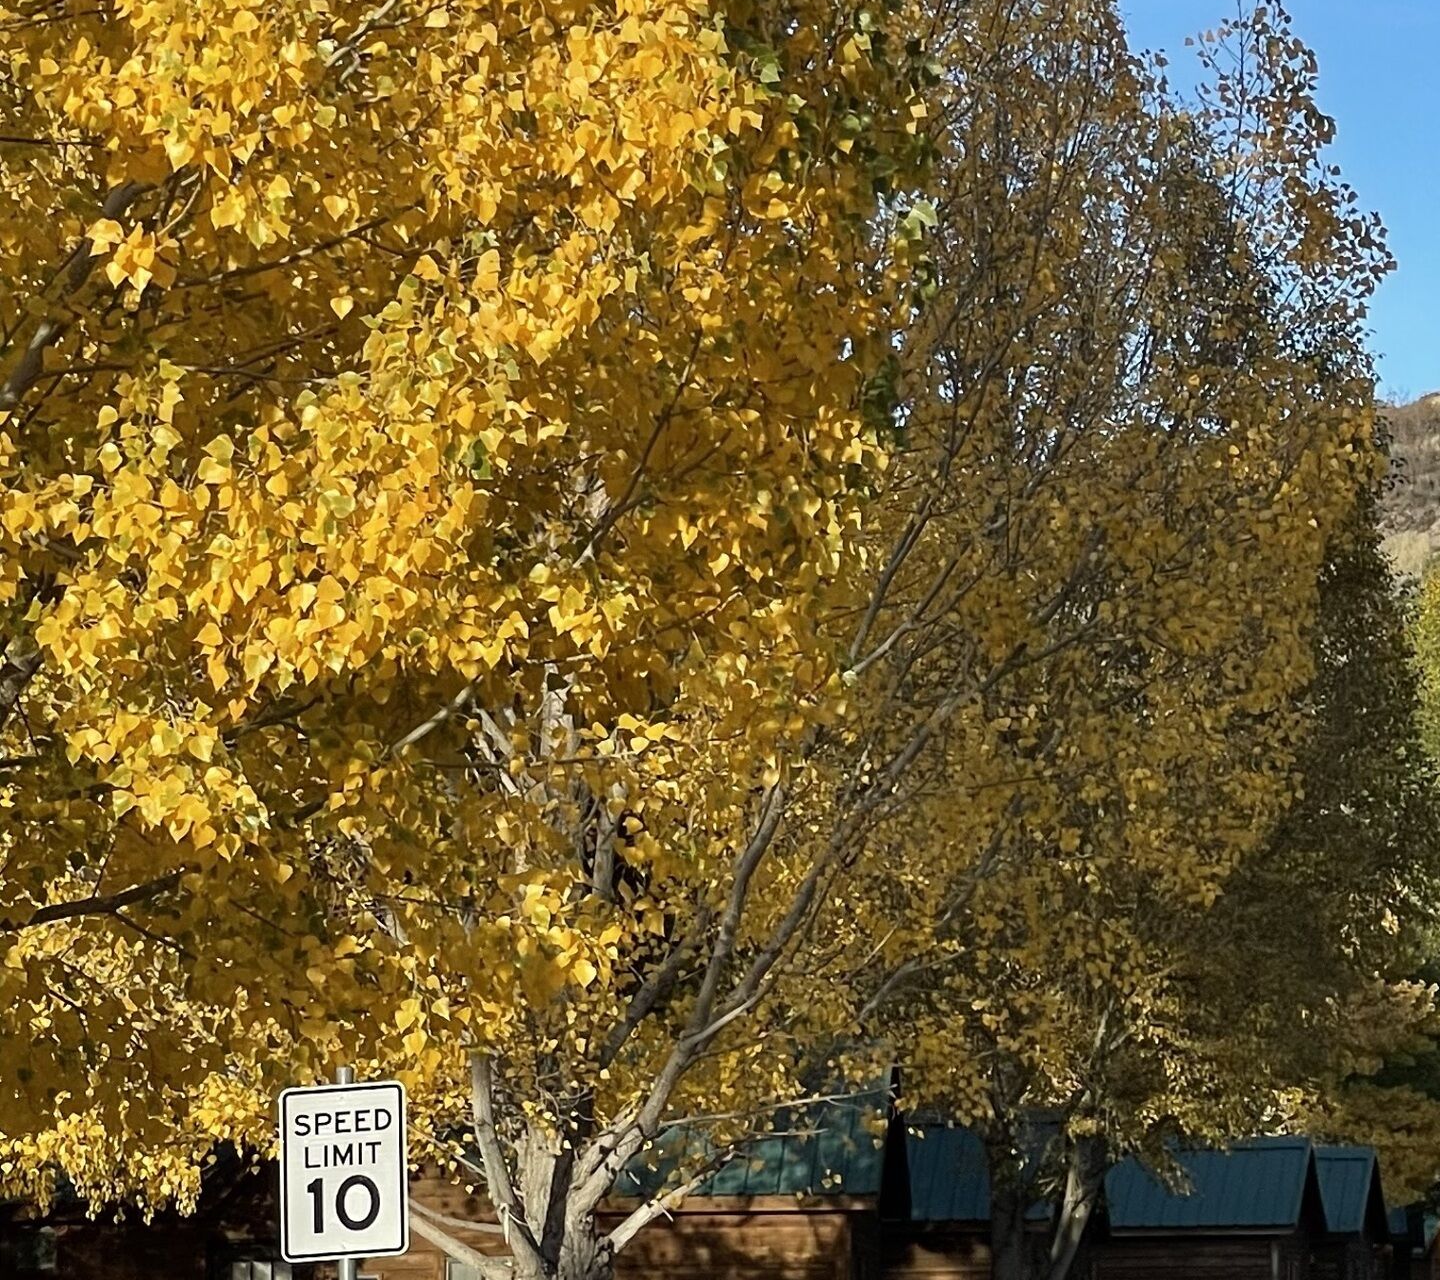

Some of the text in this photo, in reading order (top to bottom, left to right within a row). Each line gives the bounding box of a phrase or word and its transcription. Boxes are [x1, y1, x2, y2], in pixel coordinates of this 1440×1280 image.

[294, 1108, 392, 1136] SPEED
[304, 1141, 382, 1169] LIMIT
[307, 1174, 381, 1234] 10
